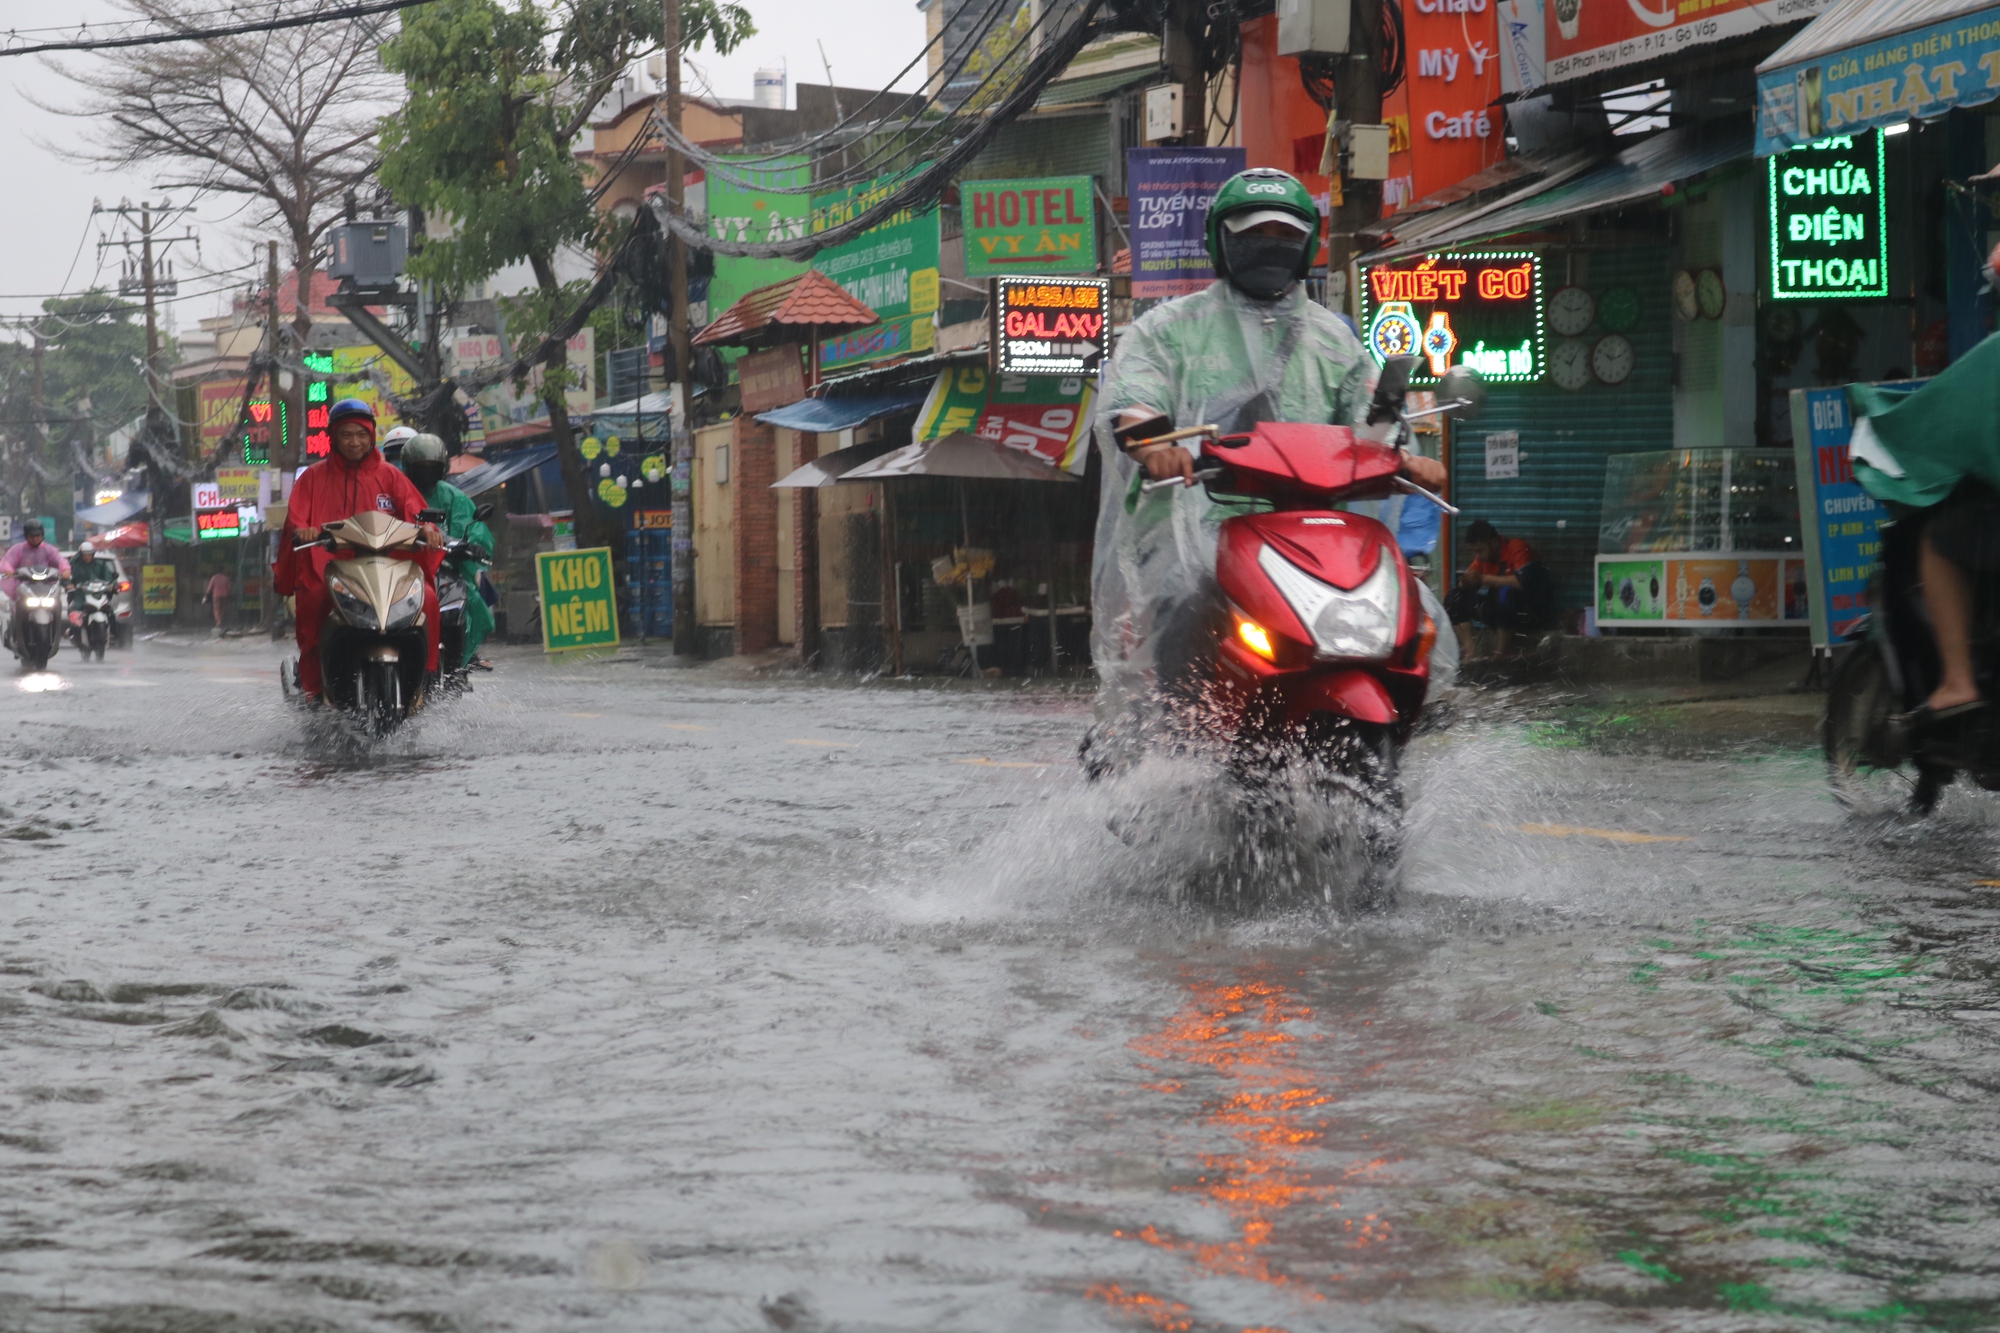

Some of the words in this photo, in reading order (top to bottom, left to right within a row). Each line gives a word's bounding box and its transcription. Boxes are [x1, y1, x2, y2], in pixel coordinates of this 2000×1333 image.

[1468, 41, 1489, 76] Ý
[1554, 62, 1570, 76] 254
[1572, 55, 1597, 72] Phan
[1598, 49, 1616, 67] Huy
[1645, 34, 1665, 51] P.12
[1675, 25, 1692, 43] Gò
[1694, 19, 1718, 38] Vấp
[1828, 57, 1859, 81] CỬA
[1865, 46, 1908, 72] HÀNG
[1913, 33, 1952, 58] ĐIỆN
[1957, 19, 2000, 46] THOẠ
[1826, 61, 1967, 129] NHẬT
[1978, 50, 2000, 89] T
[1425, 110, 1492, 139] Café
[1246, 183, 1286, 196] Grab
[1783, 160, 1872, 195] CHỮA
[973, 188, 1084, 228] HOTEL
[1138, 210, 1175, 229] LỚP
[1177, 212, 1184, 227] 1
[978, 235, 1026, 254] VY
[1037, 229, 1082, 252] ÂN
[1789, 206, 1864, 246] ĐIỆN
[1371, 259, 1467, 301] VIẾT
[1478, 263, 1531, 300] CƠ
[1781, 257, 1878, 292] THOẠI
[1007, 285, 1099, 309] MASSAGE
[1006, 310, 1102, 338] GALAXY
[1817, 444, 1855, 486] NH
[650, 514, 672, 526] JOT
[1302, 516, 1347, 526] HONDA
[550, 556, 601, 593] KHO
[551, 596, 610, 642] NỆM
